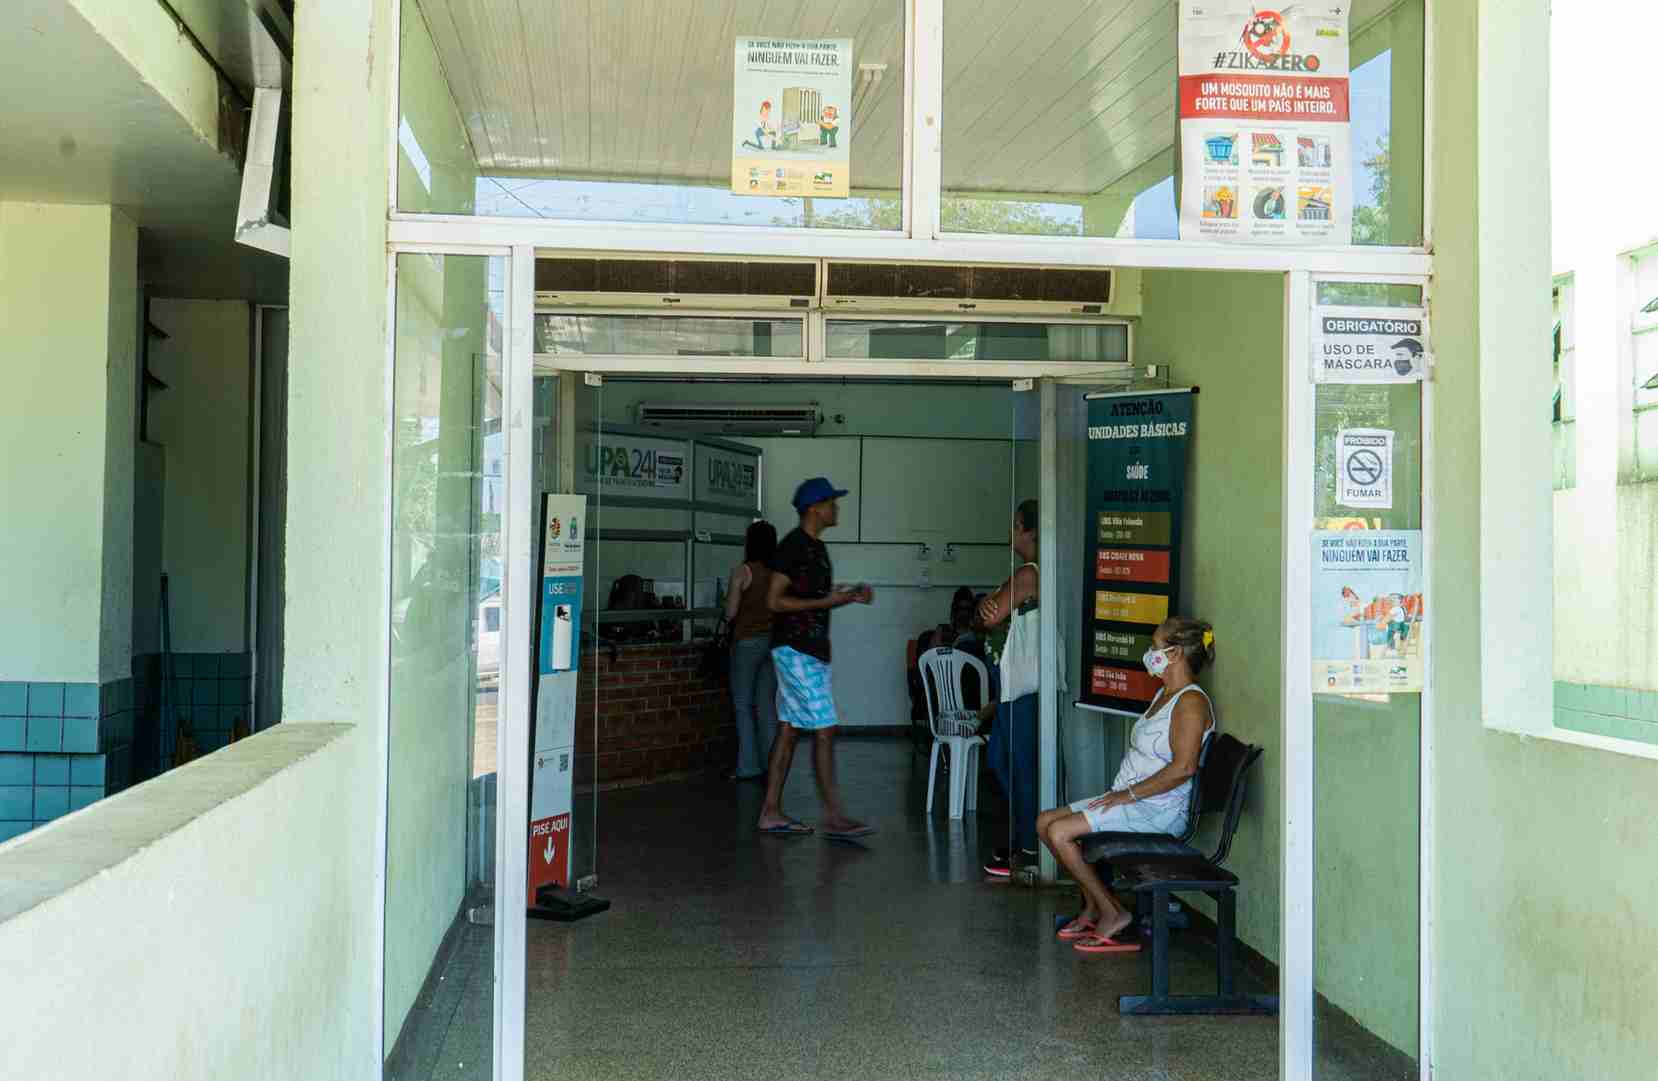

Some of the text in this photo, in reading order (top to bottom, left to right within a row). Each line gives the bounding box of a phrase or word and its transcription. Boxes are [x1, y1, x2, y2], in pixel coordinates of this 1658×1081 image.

[795, 52, 808, 65] VAI
[1211, 51, 1320, 72] #ZIKAZERO
[1201, 82, 1217, 95] UM
[1221, 83, 1271, 97] MOSQUITO
[1273, 82, 1294, 98] NÃO
[1304, 86, 1331, 99] MAIS
[1195, 97, 1336, 114] FORTE QUE UM PAÍS INTEIRO.
[1323, 344, 1374, 355] USO DE
[1088, 421, 1187, 440] UNIDADES BÁSICAS
[1126, 460, 1150, 480] SAÚDE
[1346, 488, 1381, 497] FUMAR
[1367, 549, 1380, 562] VAI
[1383, 549, 1410, 562] FAZER.
[533, 816, 568, 838] PISE AQUI
